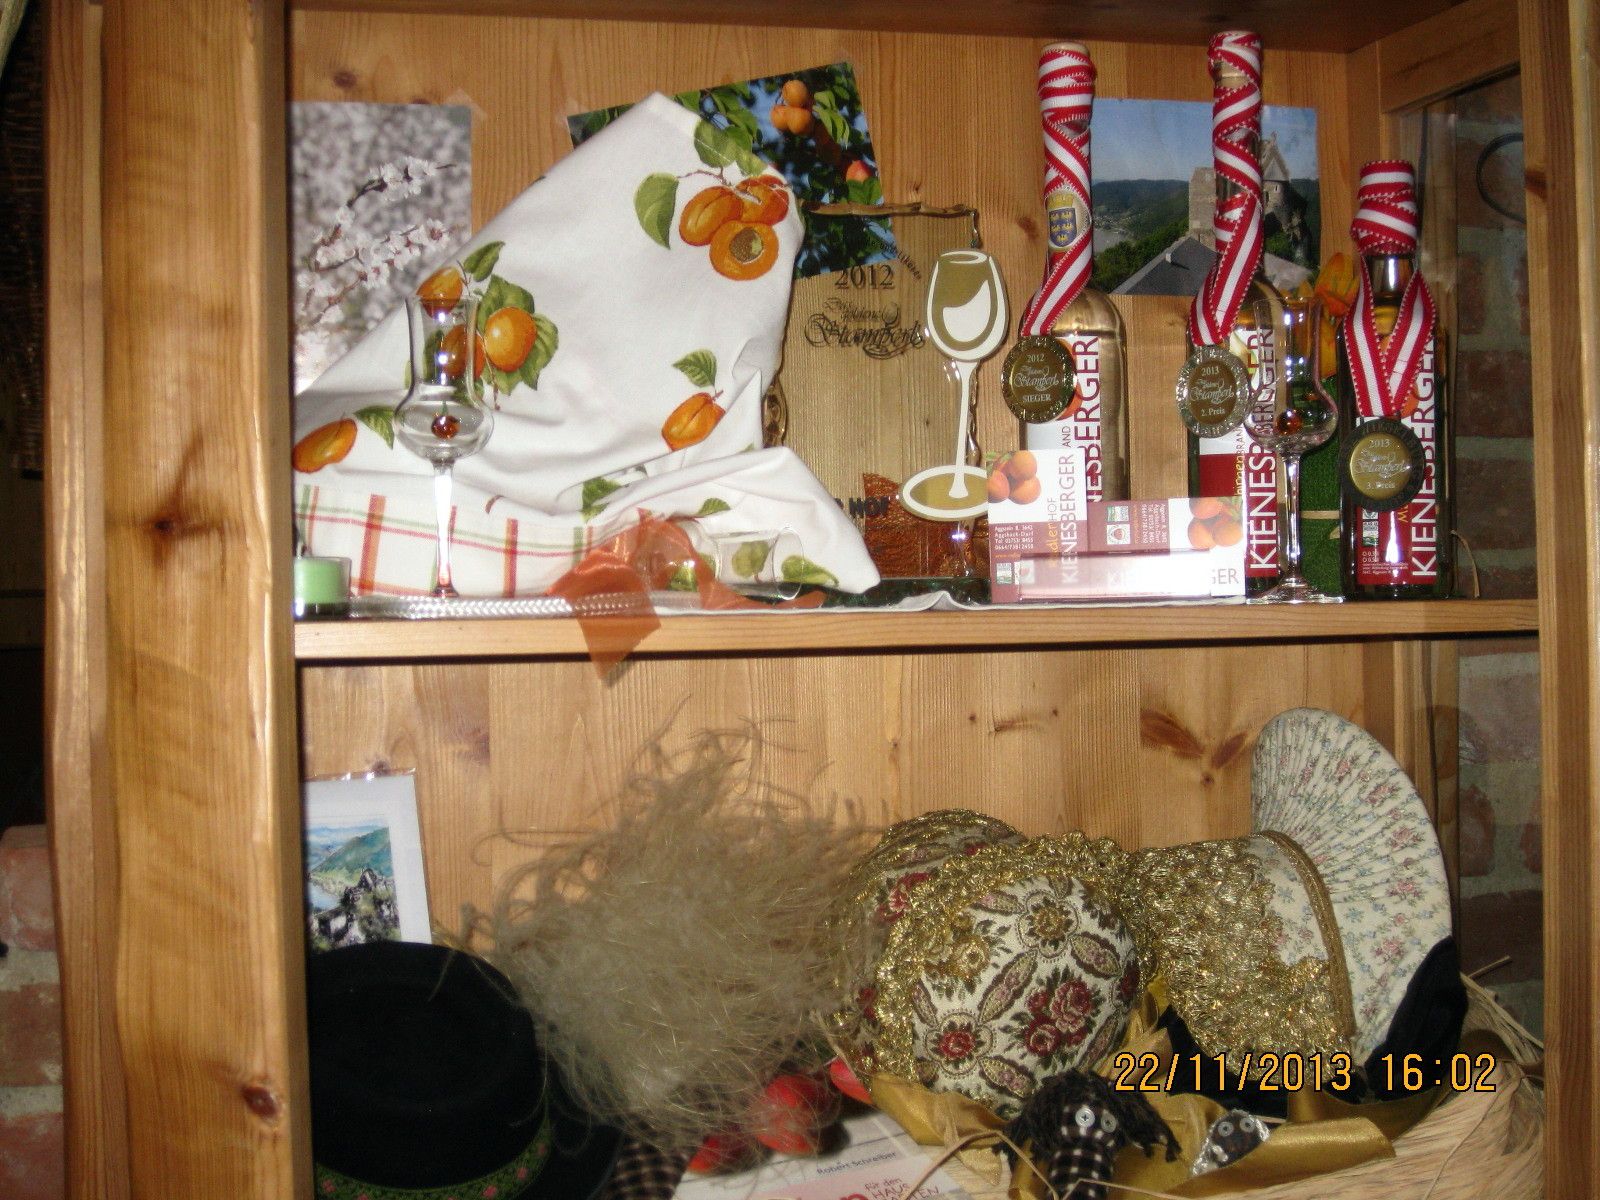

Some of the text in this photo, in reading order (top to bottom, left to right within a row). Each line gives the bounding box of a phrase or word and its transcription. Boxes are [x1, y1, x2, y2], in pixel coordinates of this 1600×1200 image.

[835, 264, 894, 290] 2012
[1201, 366, 1220, 376] 2013
[1021, 393, 1052, 403] SIEGER
